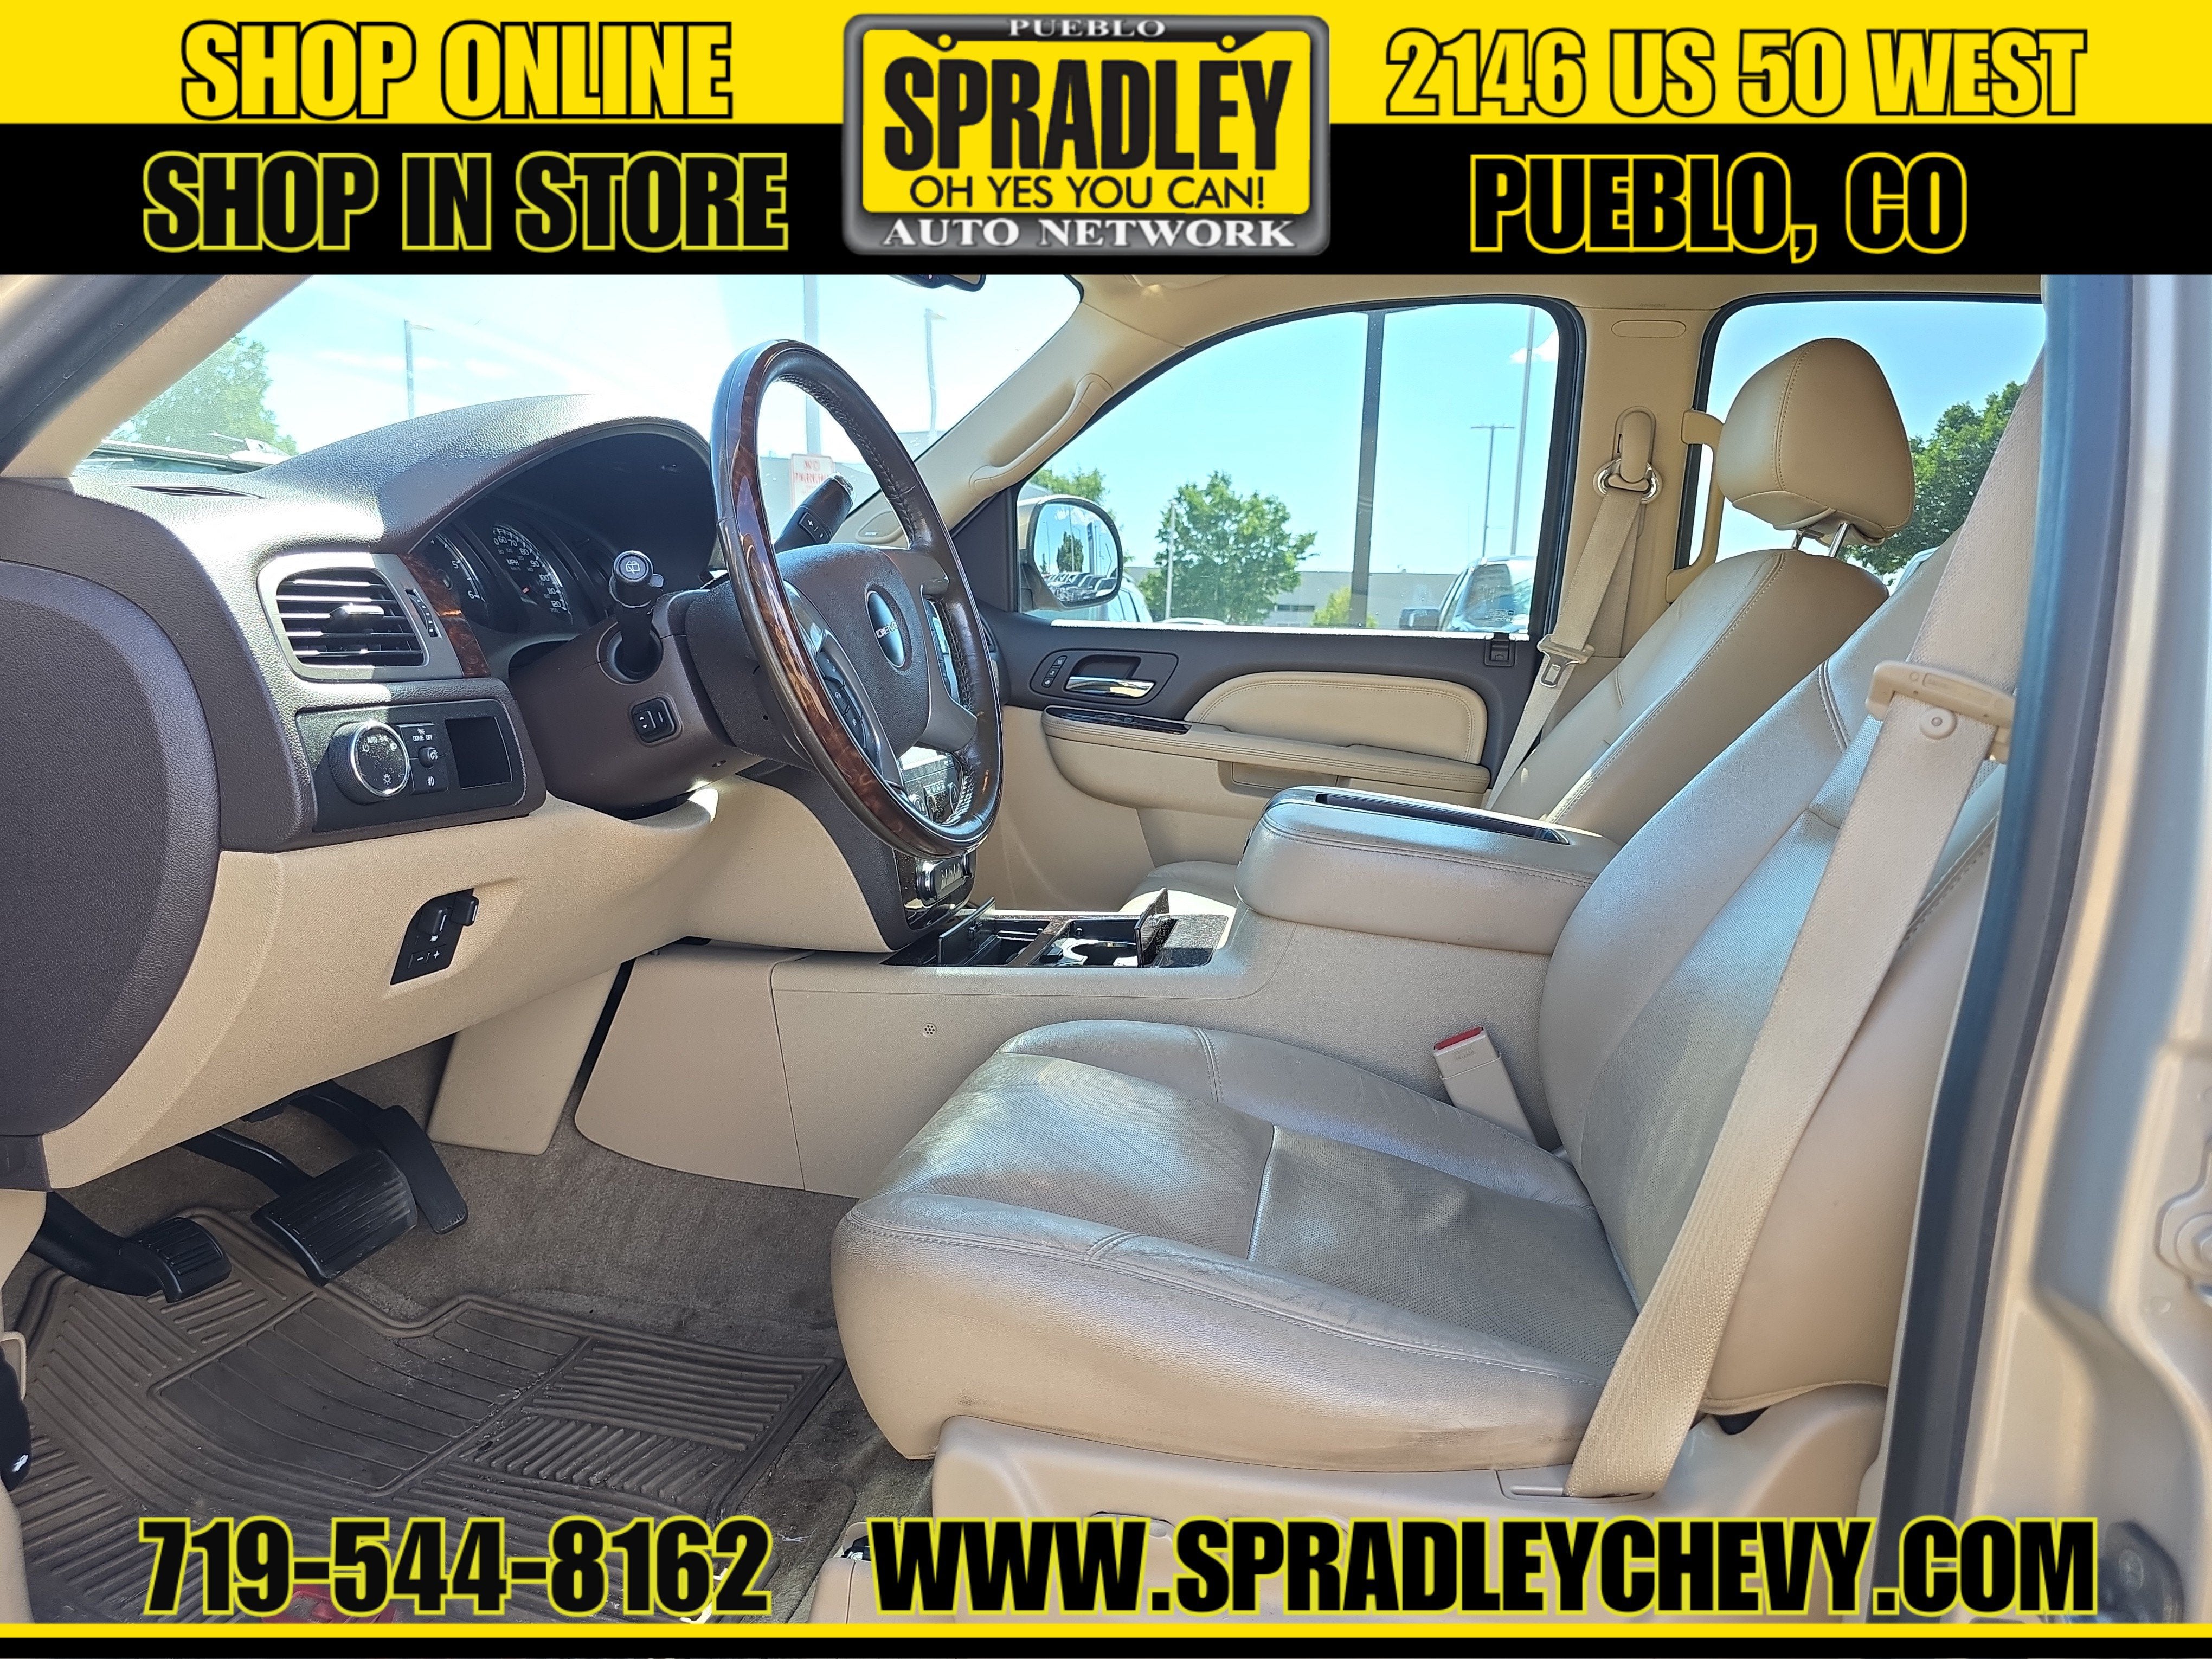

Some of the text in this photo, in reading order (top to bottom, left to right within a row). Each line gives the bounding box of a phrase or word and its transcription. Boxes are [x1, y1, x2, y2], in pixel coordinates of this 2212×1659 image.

[804, 460, 820, 471] NO
[507, 539, 518, 547] 70
[519, 548, 529, 556] 80
[451, 560, 459, 569] 5
[530, 560, 540, 568] 90
[538, 574, 550, 582] 100
[467, 590, 474, 599] 6
[367, 736, 378, 744] AUTO
